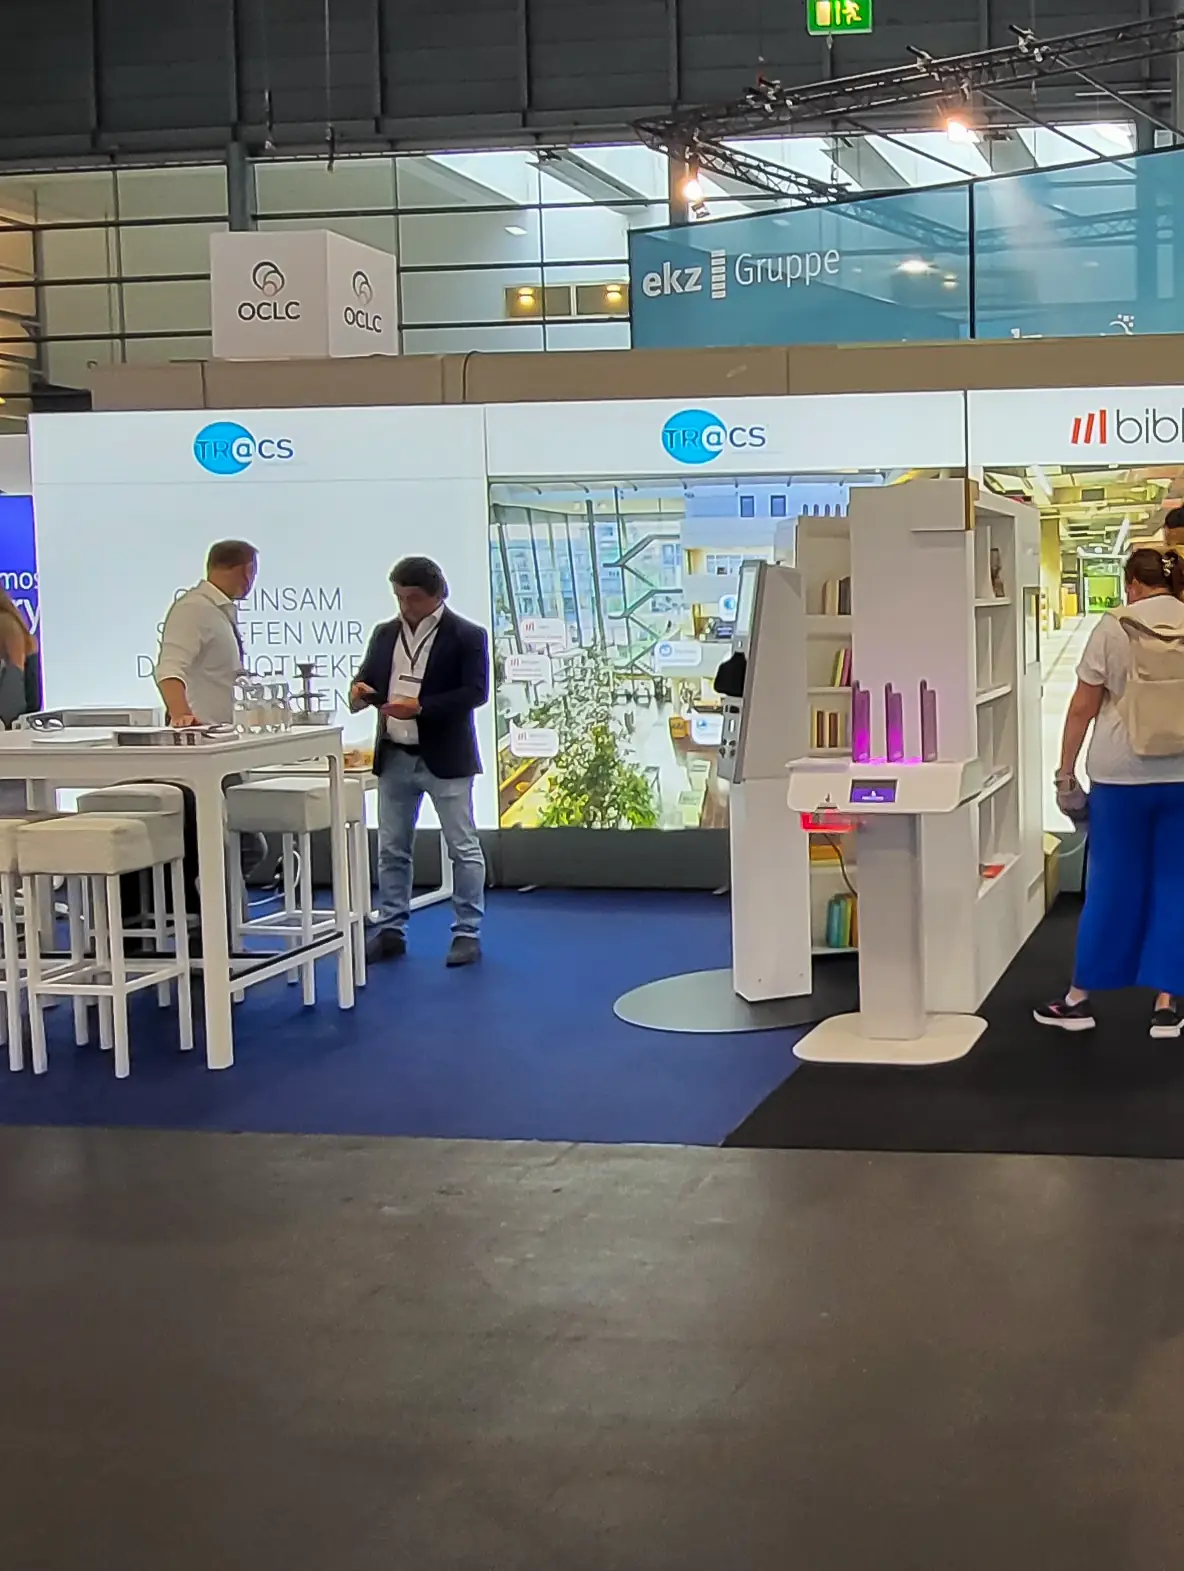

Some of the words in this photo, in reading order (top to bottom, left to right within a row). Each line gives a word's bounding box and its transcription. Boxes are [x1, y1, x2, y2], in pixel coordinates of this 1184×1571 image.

[641, 261, 702, 297] ekz
[734, 247, 840, 287] Gruppe
[237, 301, 301, 321] OCLC
[343, 306, 382, 333] OCLC
[311, 620, 363, 645] WIR
